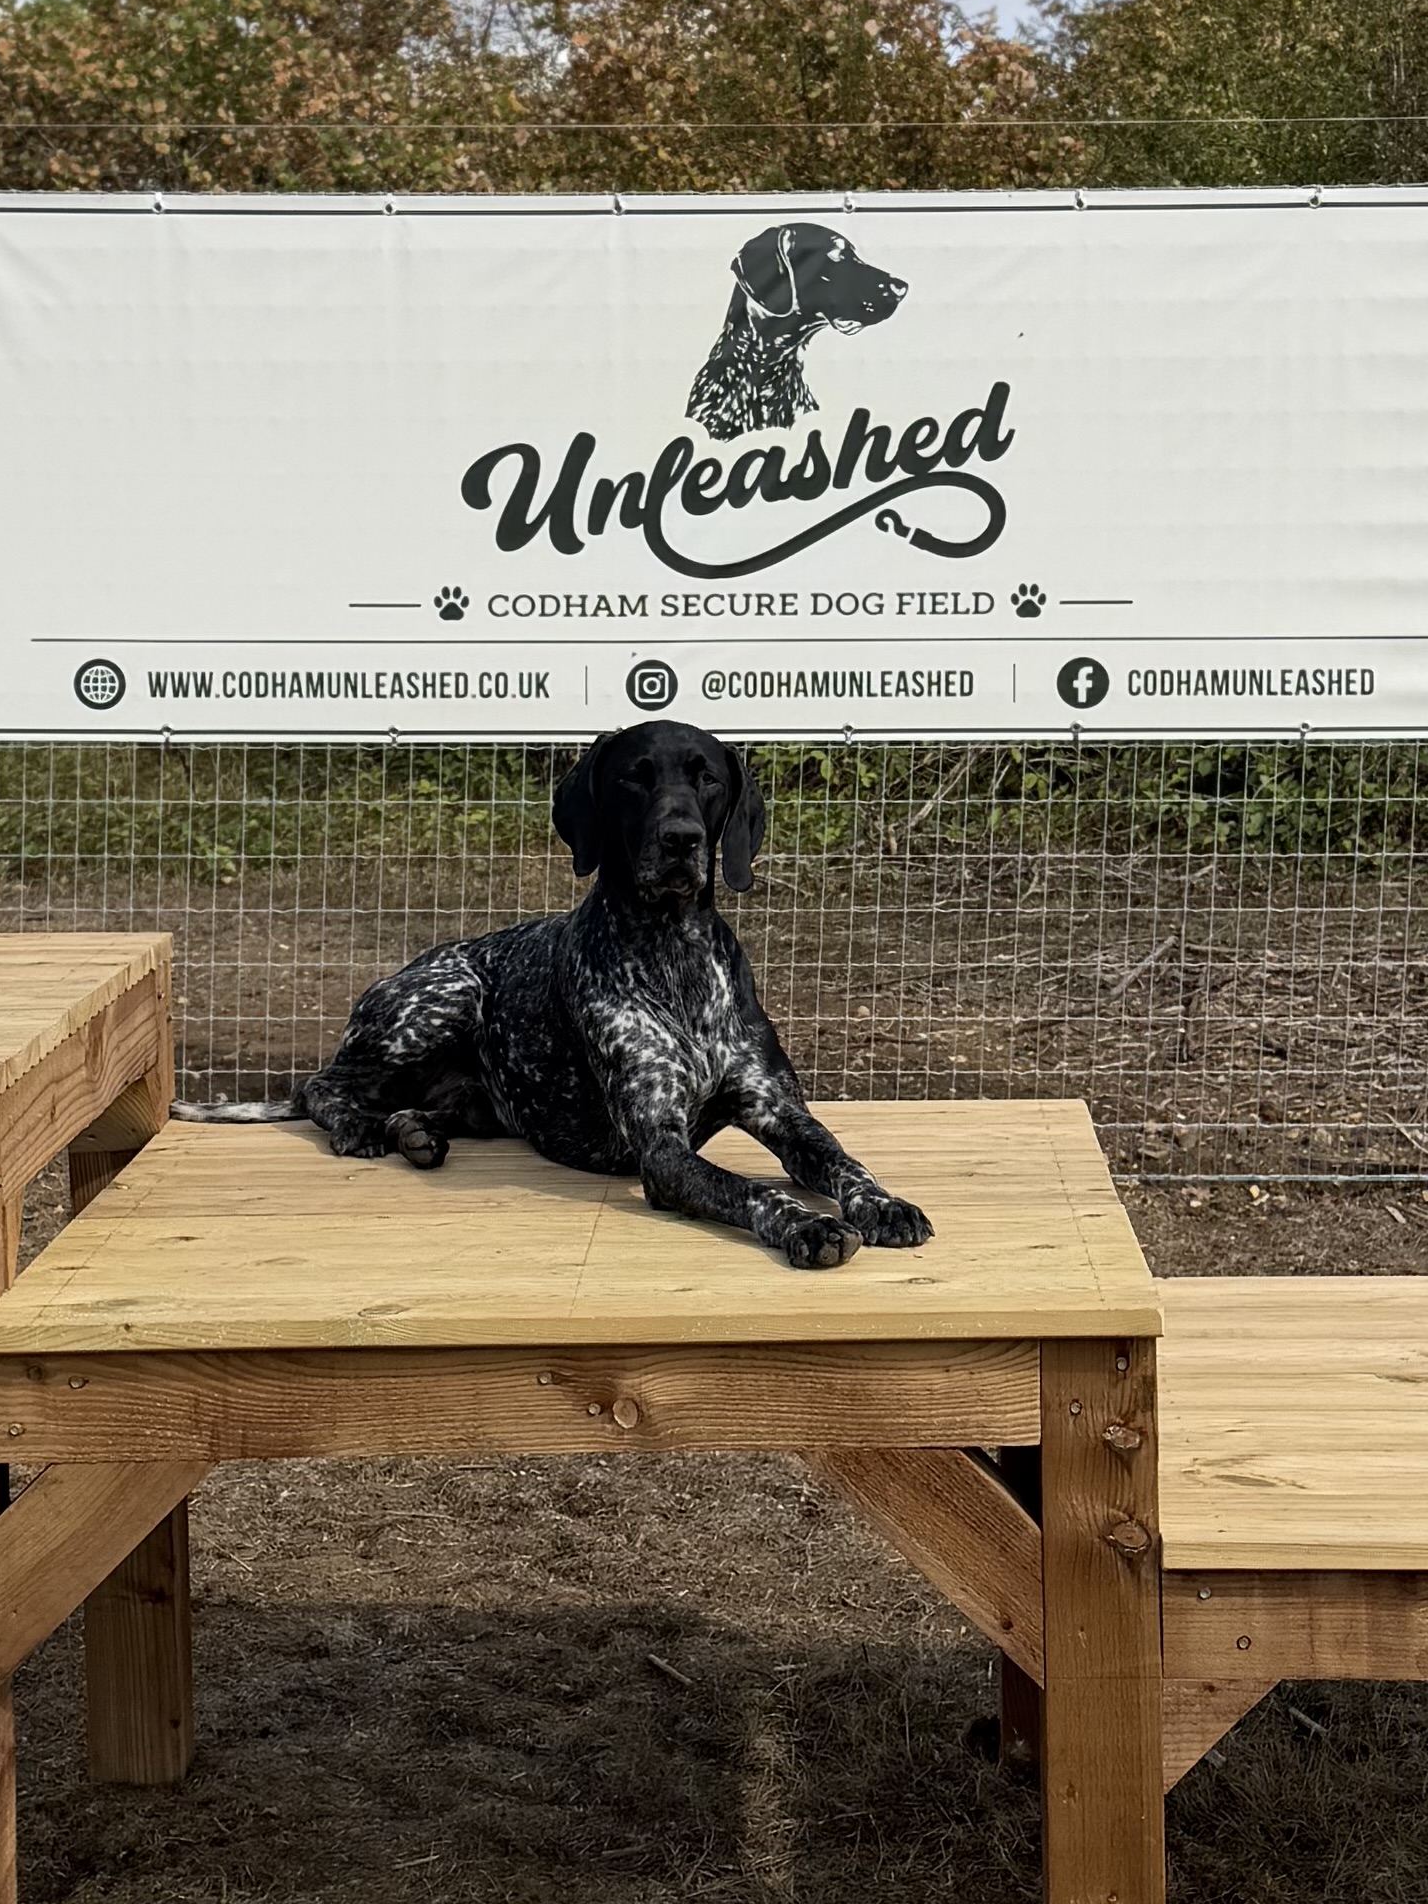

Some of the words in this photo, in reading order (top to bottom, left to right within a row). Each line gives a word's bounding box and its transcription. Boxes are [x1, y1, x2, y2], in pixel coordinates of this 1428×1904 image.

[461, 381, 1016, 580] Unleashed
[487, 593, 649, 618] CODHAM
[660, 592, 799, 617] SECURE
[810, 591, 885, 616] DOG
[895, 591, 995, 616] FIELD
[146, 670, 551, 700] WWW.CODHAMUNLEASHED.CO.UK
[700, 670, 975, 701] @CODHAMUNLEASHED
[1127, 668, 1375, 698] CODHAMUNLEASHED
